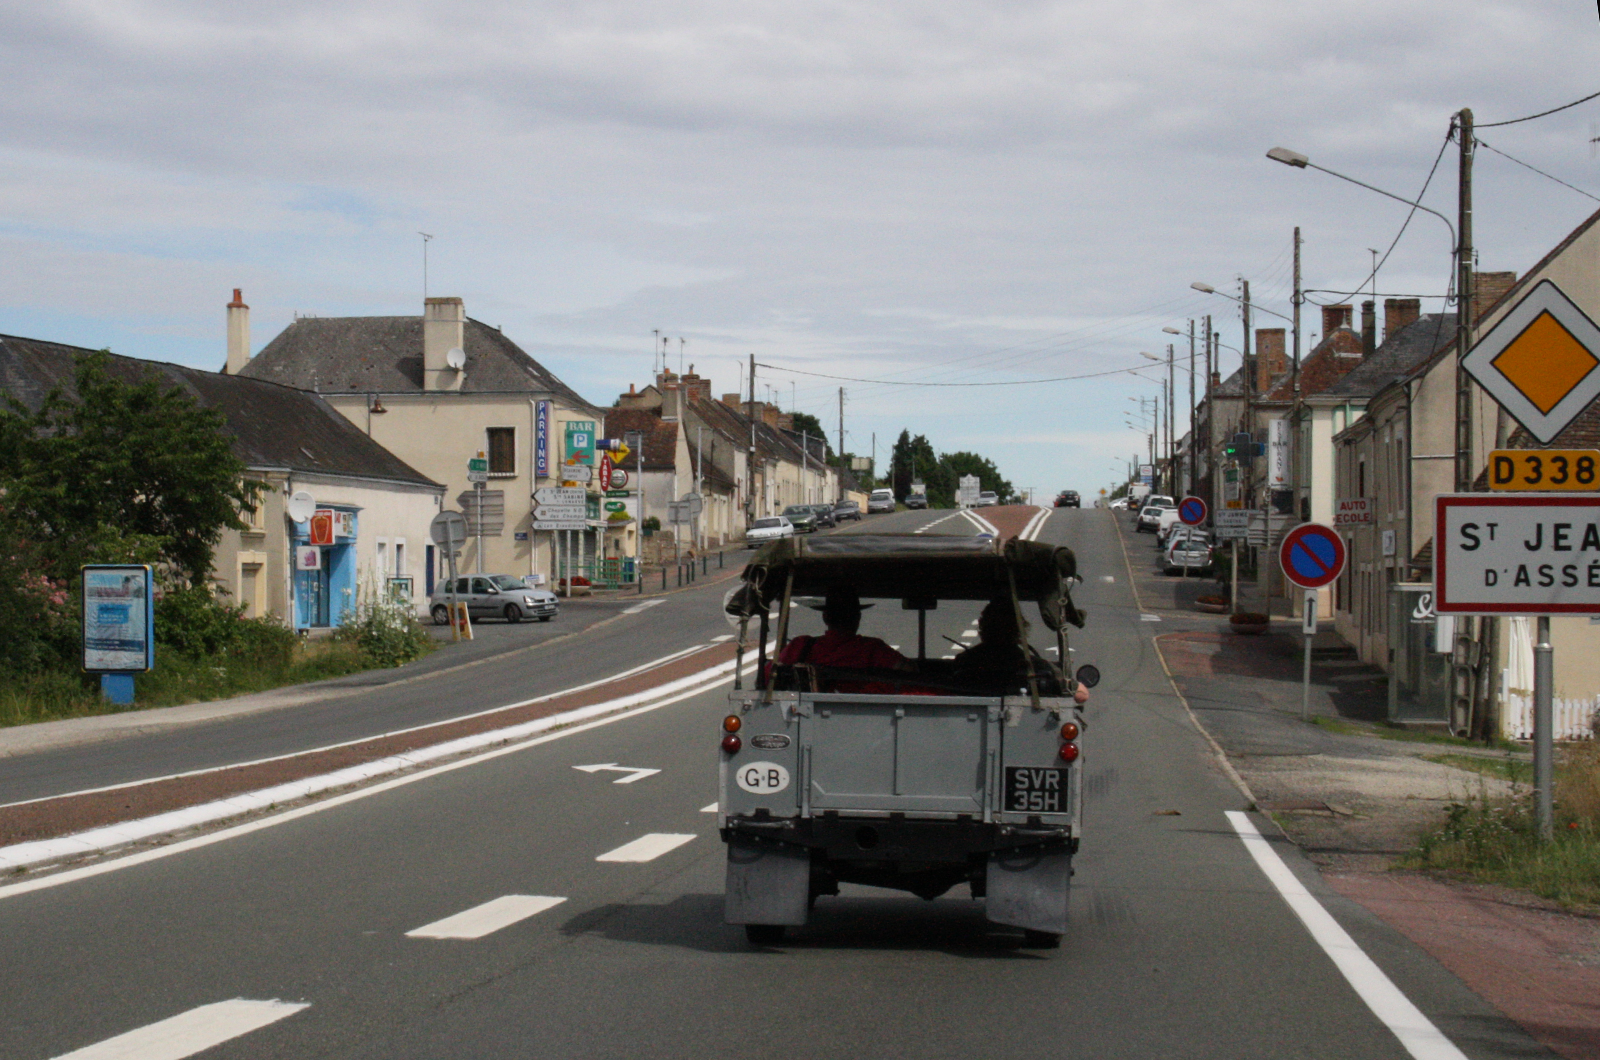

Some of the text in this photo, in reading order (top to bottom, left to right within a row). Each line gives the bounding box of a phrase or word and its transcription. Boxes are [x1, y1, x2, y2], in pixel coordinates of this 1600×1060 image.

[569, 422, 592, 431] BAR
[1340, 500, 1366, 510] AUTO
[1336, 512, 1370, 523] ECOLE
[1015, 768, 1059, 790] SVR
[1014, 790, 1058, 810] 35H
